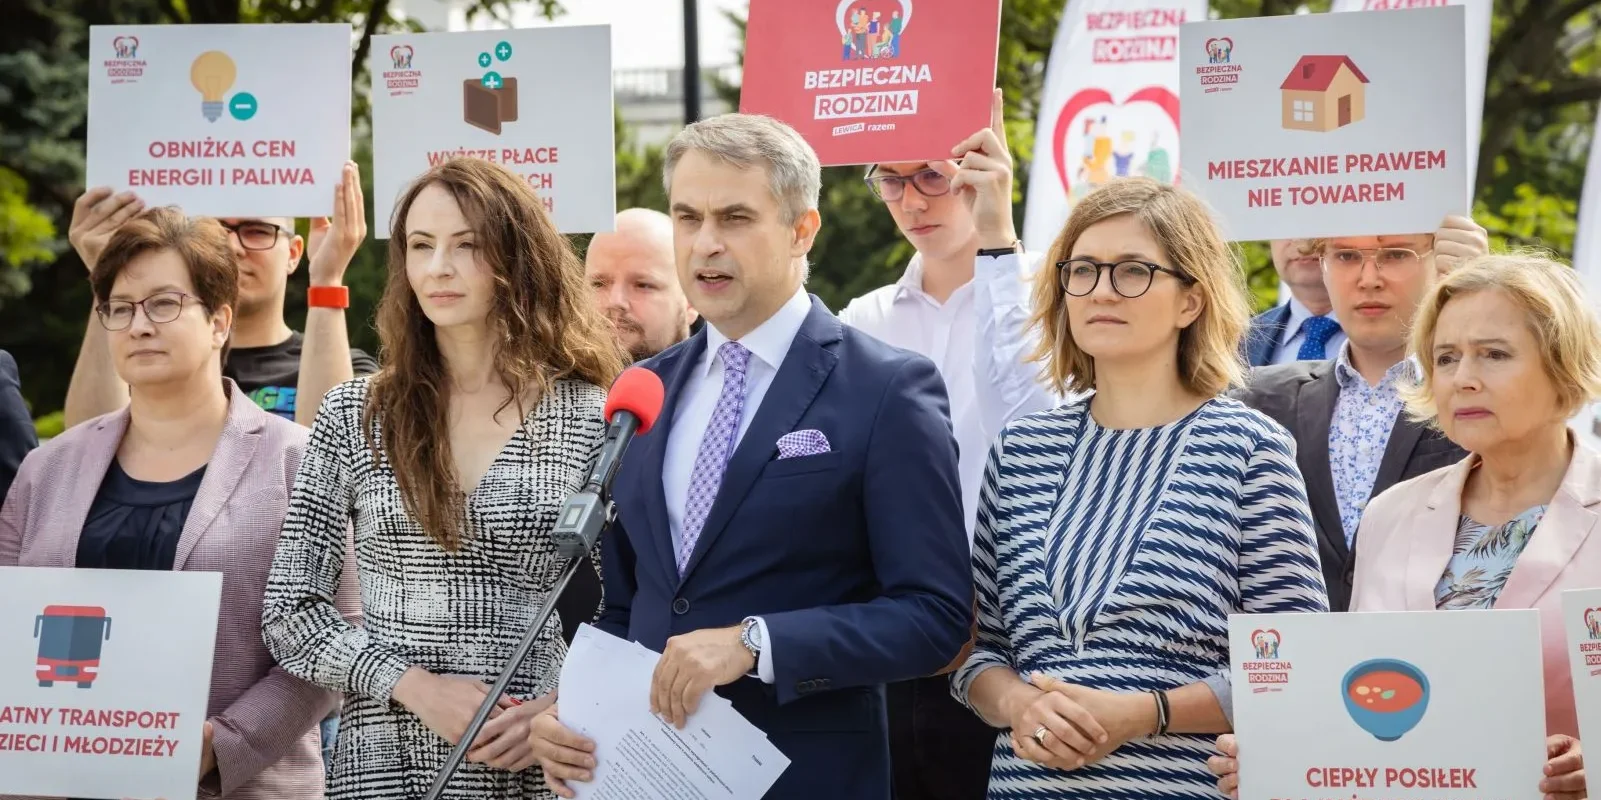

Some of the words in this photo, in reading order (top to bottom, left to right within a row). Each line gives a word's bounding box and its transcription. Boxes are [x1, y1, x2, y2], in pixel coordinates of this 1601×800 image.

[804, 64, 933, 89] BEZPIECZNA
[1196, 65, 1242, 74] BEZPIECZNA
[1202, 75, 1237, 85] RODZINA
[818, 94, 913, 116] RODZINA
[834, 124, 863, 135] LEWICA
[867, 123, 896, 131] razem
[149, 136, 246, 159] OBNIŻKA
[252, 140, 295, 158] CEN
[502, 147, 558, 164] PŁACE
[1208, 155, 1338, 180] MIESZKANIE
[1345, 150, 1446, 173] PRAWEM
[128, 169, 212, 186] ENERGII
[219, 169, 224, 185] I
[232, 168, 315, 185] PALIWA
[1248, 188, 1282, 208] NIE
[1288, 182, 1405, 206] TOWAREM
[1580, 642, 1601, 652] BEZPIE
[1242, 661, 1292, 670] BEZPIECZNA
[1586, 655, 1601, 664] ROD
[1249, 673, 1287, 682] RODZINA
[0, 706, 52, 725] ATNY
[58, 708, 180, 729] TRANSPORT
[0, 734, 47, 752] ZIECI
[52, 735, 58, 752] I
[64, 734, 180, 757] MŁODZIEŻY
[1306, 767, 1378, 789] CIEPŁY
[1385, 767, 1477, 789] POSIŁEK
